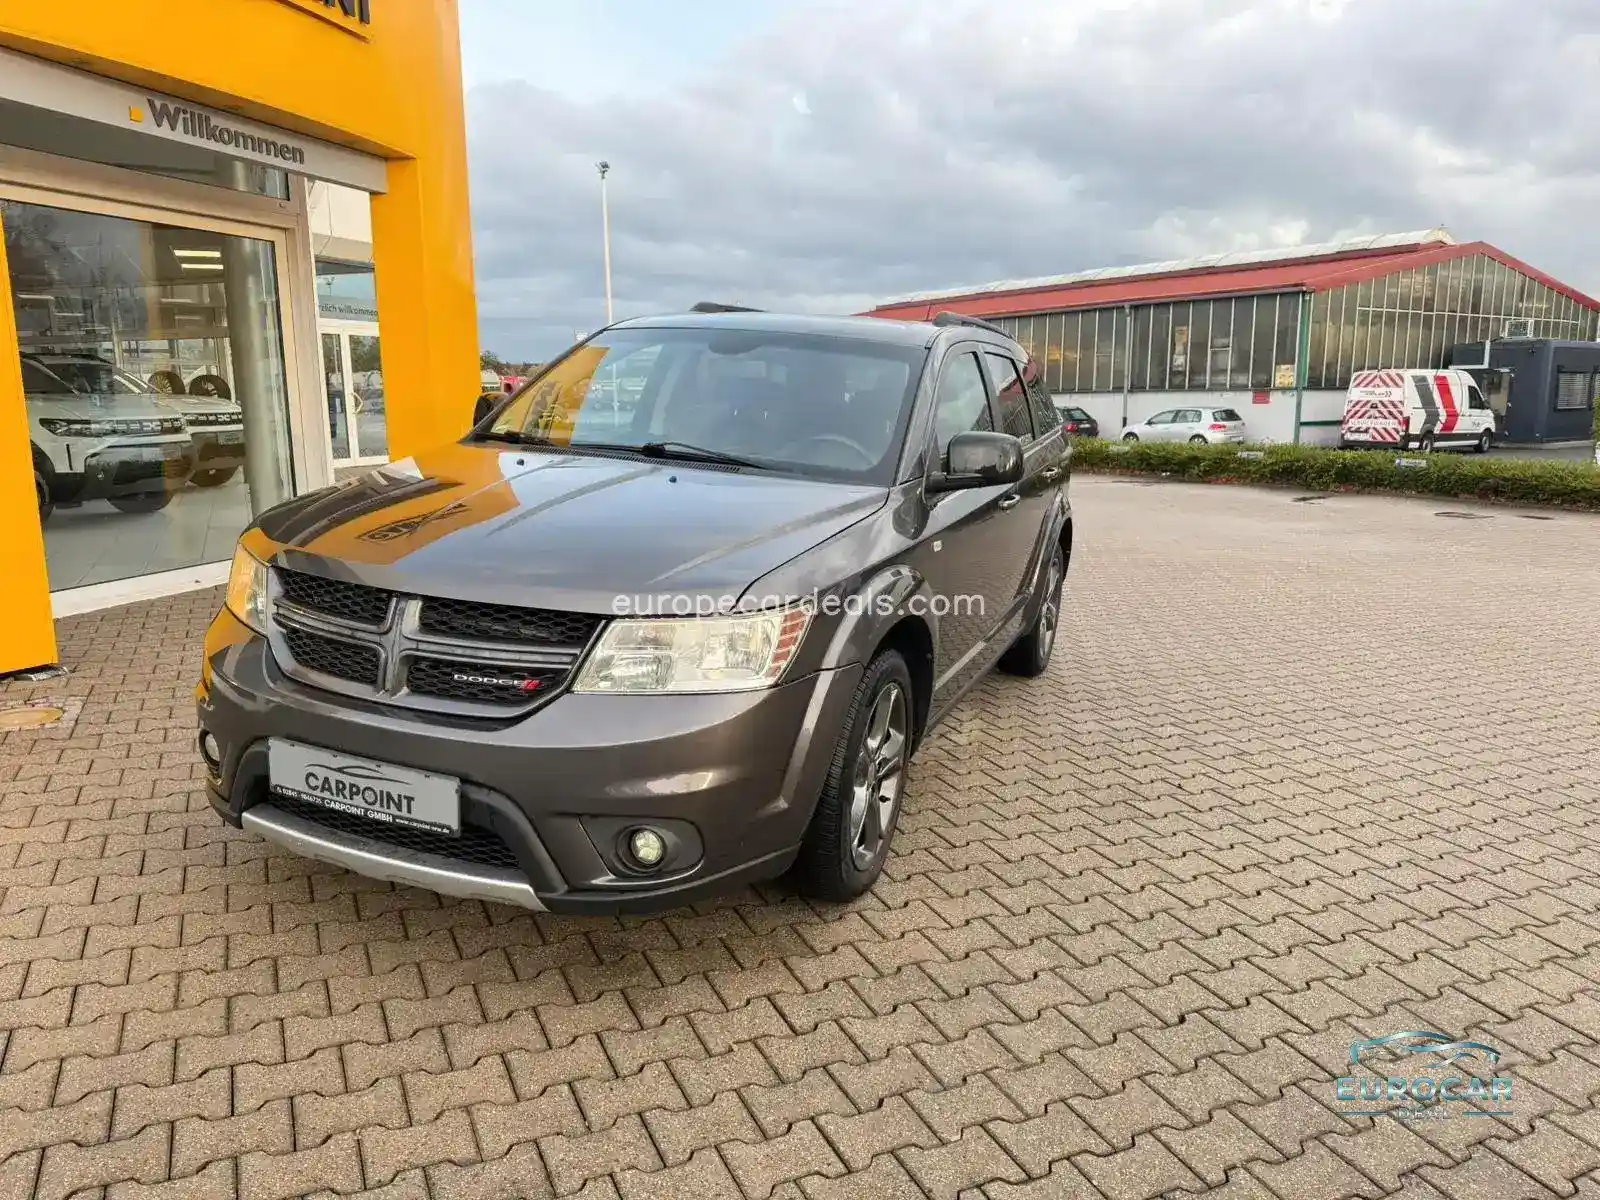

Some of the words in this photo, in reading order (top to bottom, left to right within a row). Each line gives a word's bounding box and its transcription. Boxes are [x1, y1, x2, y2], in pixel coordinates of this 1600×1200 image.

[146, 97, 305, 165] Willkommen
[453, 673, 524, 687] DODGE
[304, 771, 416, 815] CARPOINT
[324, 799, 365, 817] CARPOINT
[366, 809, 393, 823] GMBH
